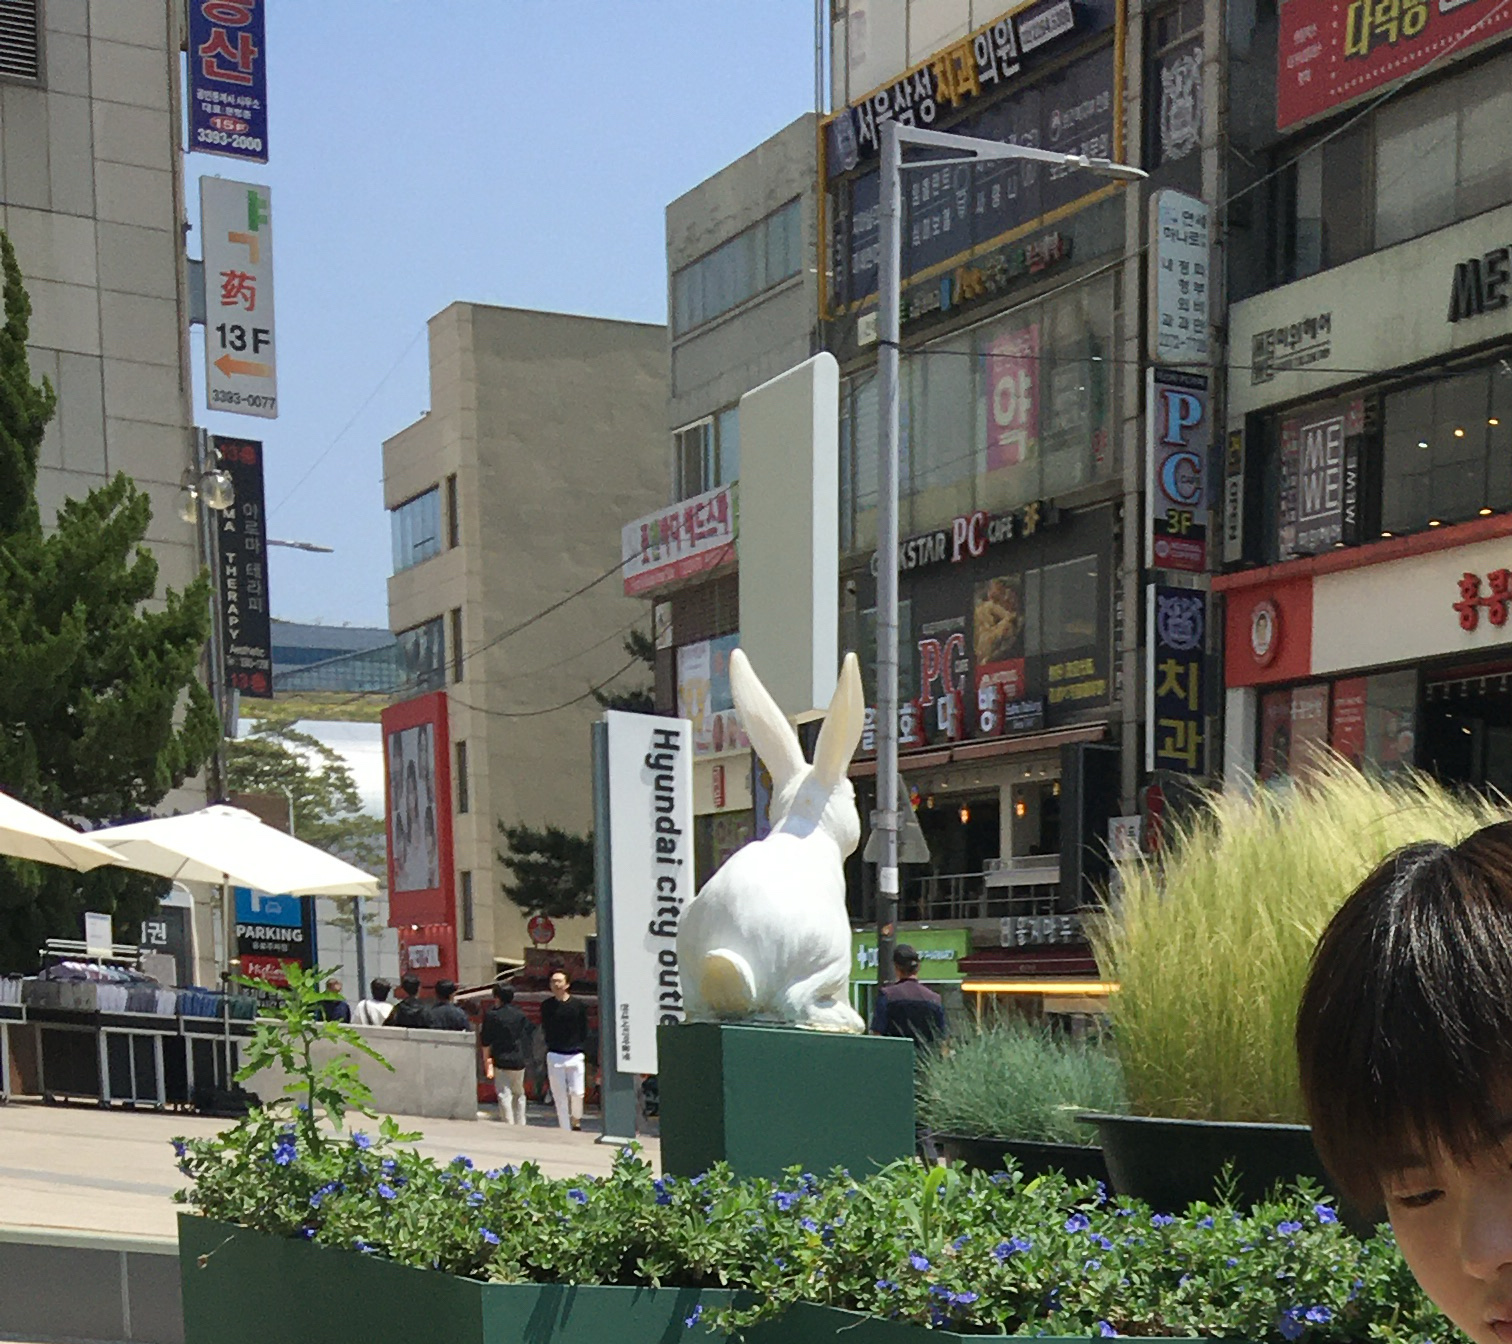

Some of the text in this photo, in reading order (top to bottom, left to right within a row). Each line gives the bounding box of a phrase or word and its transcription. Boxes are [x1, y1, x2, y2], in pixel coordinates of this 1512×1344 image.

[220, 270, 257, 311] 药
[1159, 389, 1203, 506] PC
[951, 511, 984, 562] PC
[1167, 509, 1193, 534] 3F
[225, 551, 240, 641] THERAPY
[1157, 658, 1205, 769] 치과
[645, 728, 686, 1026] Hyundai city outle
[235, 923, 304, 943] PARKING
